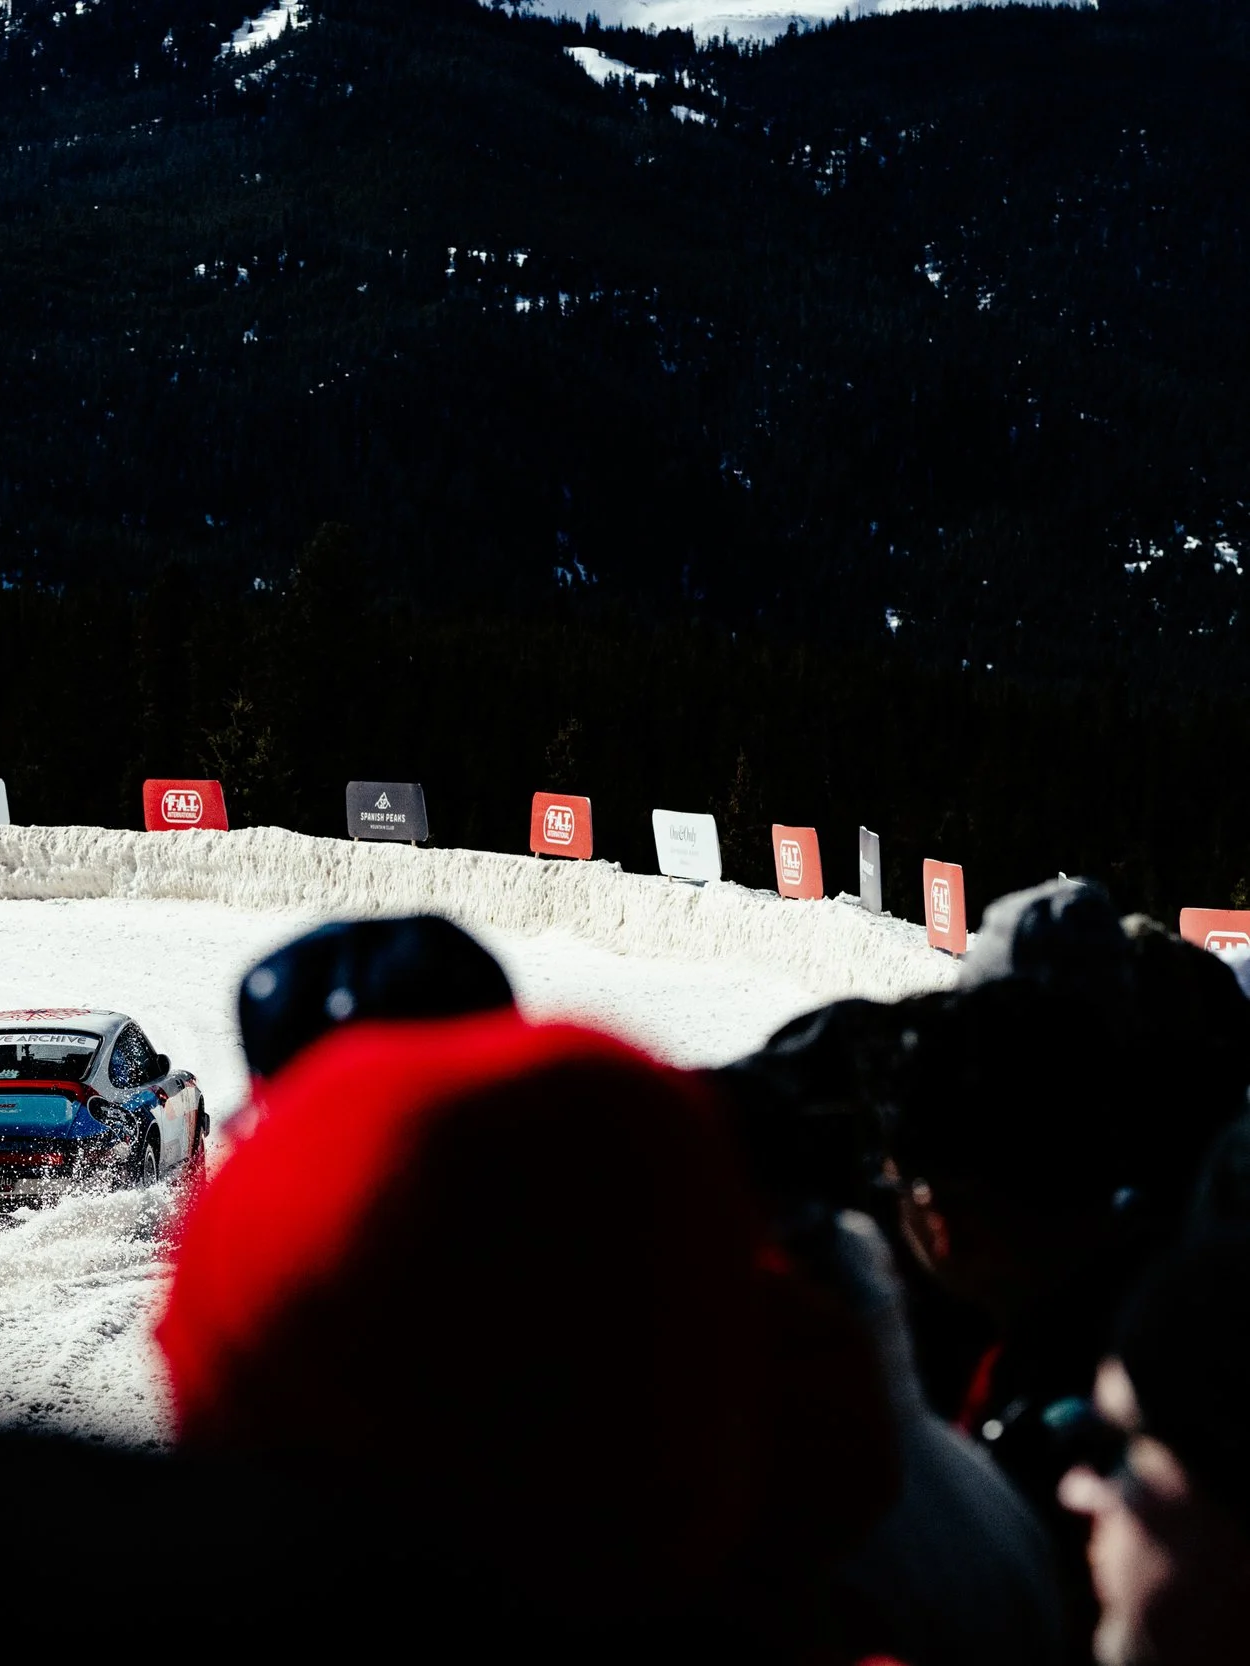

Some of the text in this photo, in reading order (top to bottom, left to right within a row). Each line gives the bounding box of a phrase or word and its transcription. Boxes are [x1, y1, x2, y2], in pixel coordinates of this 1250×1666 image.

[360, 812, 406, 822] SPANISH PEAKS
[17, 1034, 87, 1045] ARCHIVE
